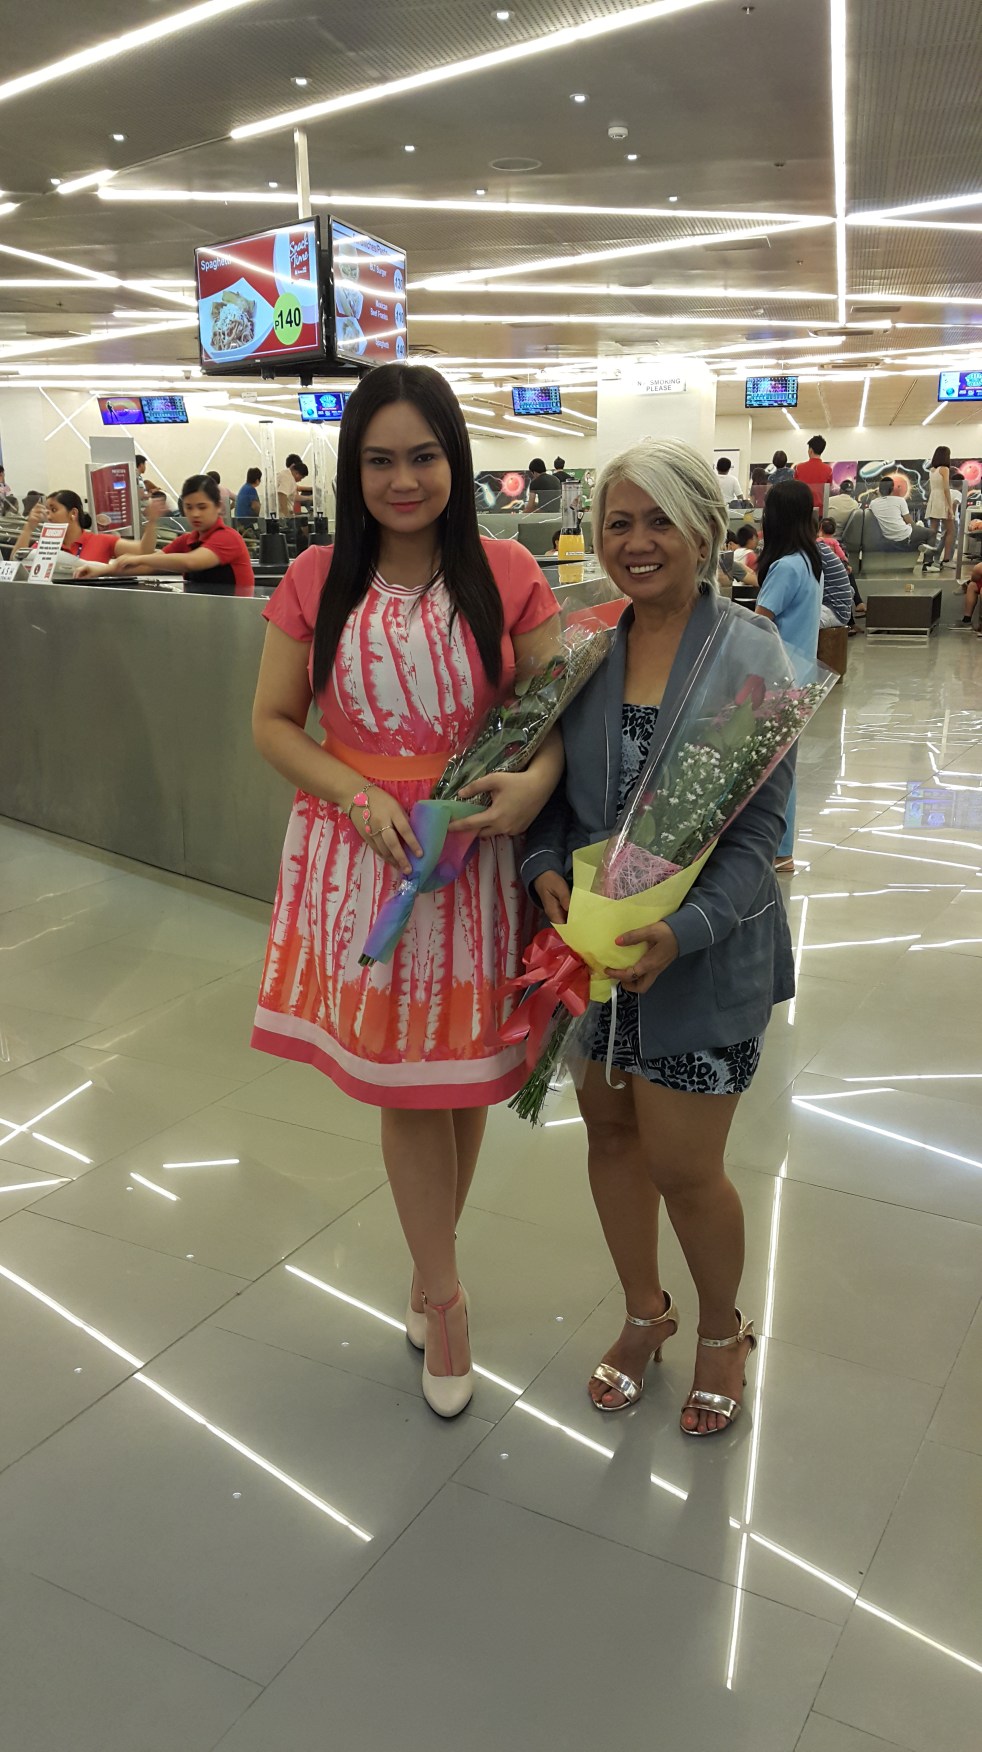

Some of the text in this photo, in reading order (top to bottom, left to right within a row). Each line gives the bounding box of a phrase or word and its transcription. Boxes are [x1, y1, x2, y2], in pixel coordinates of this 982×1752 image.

[290, 231, 309, 257] Snack
[290, 251, 309, 268] Time
[650, 378, 681, 386] SMOKING
